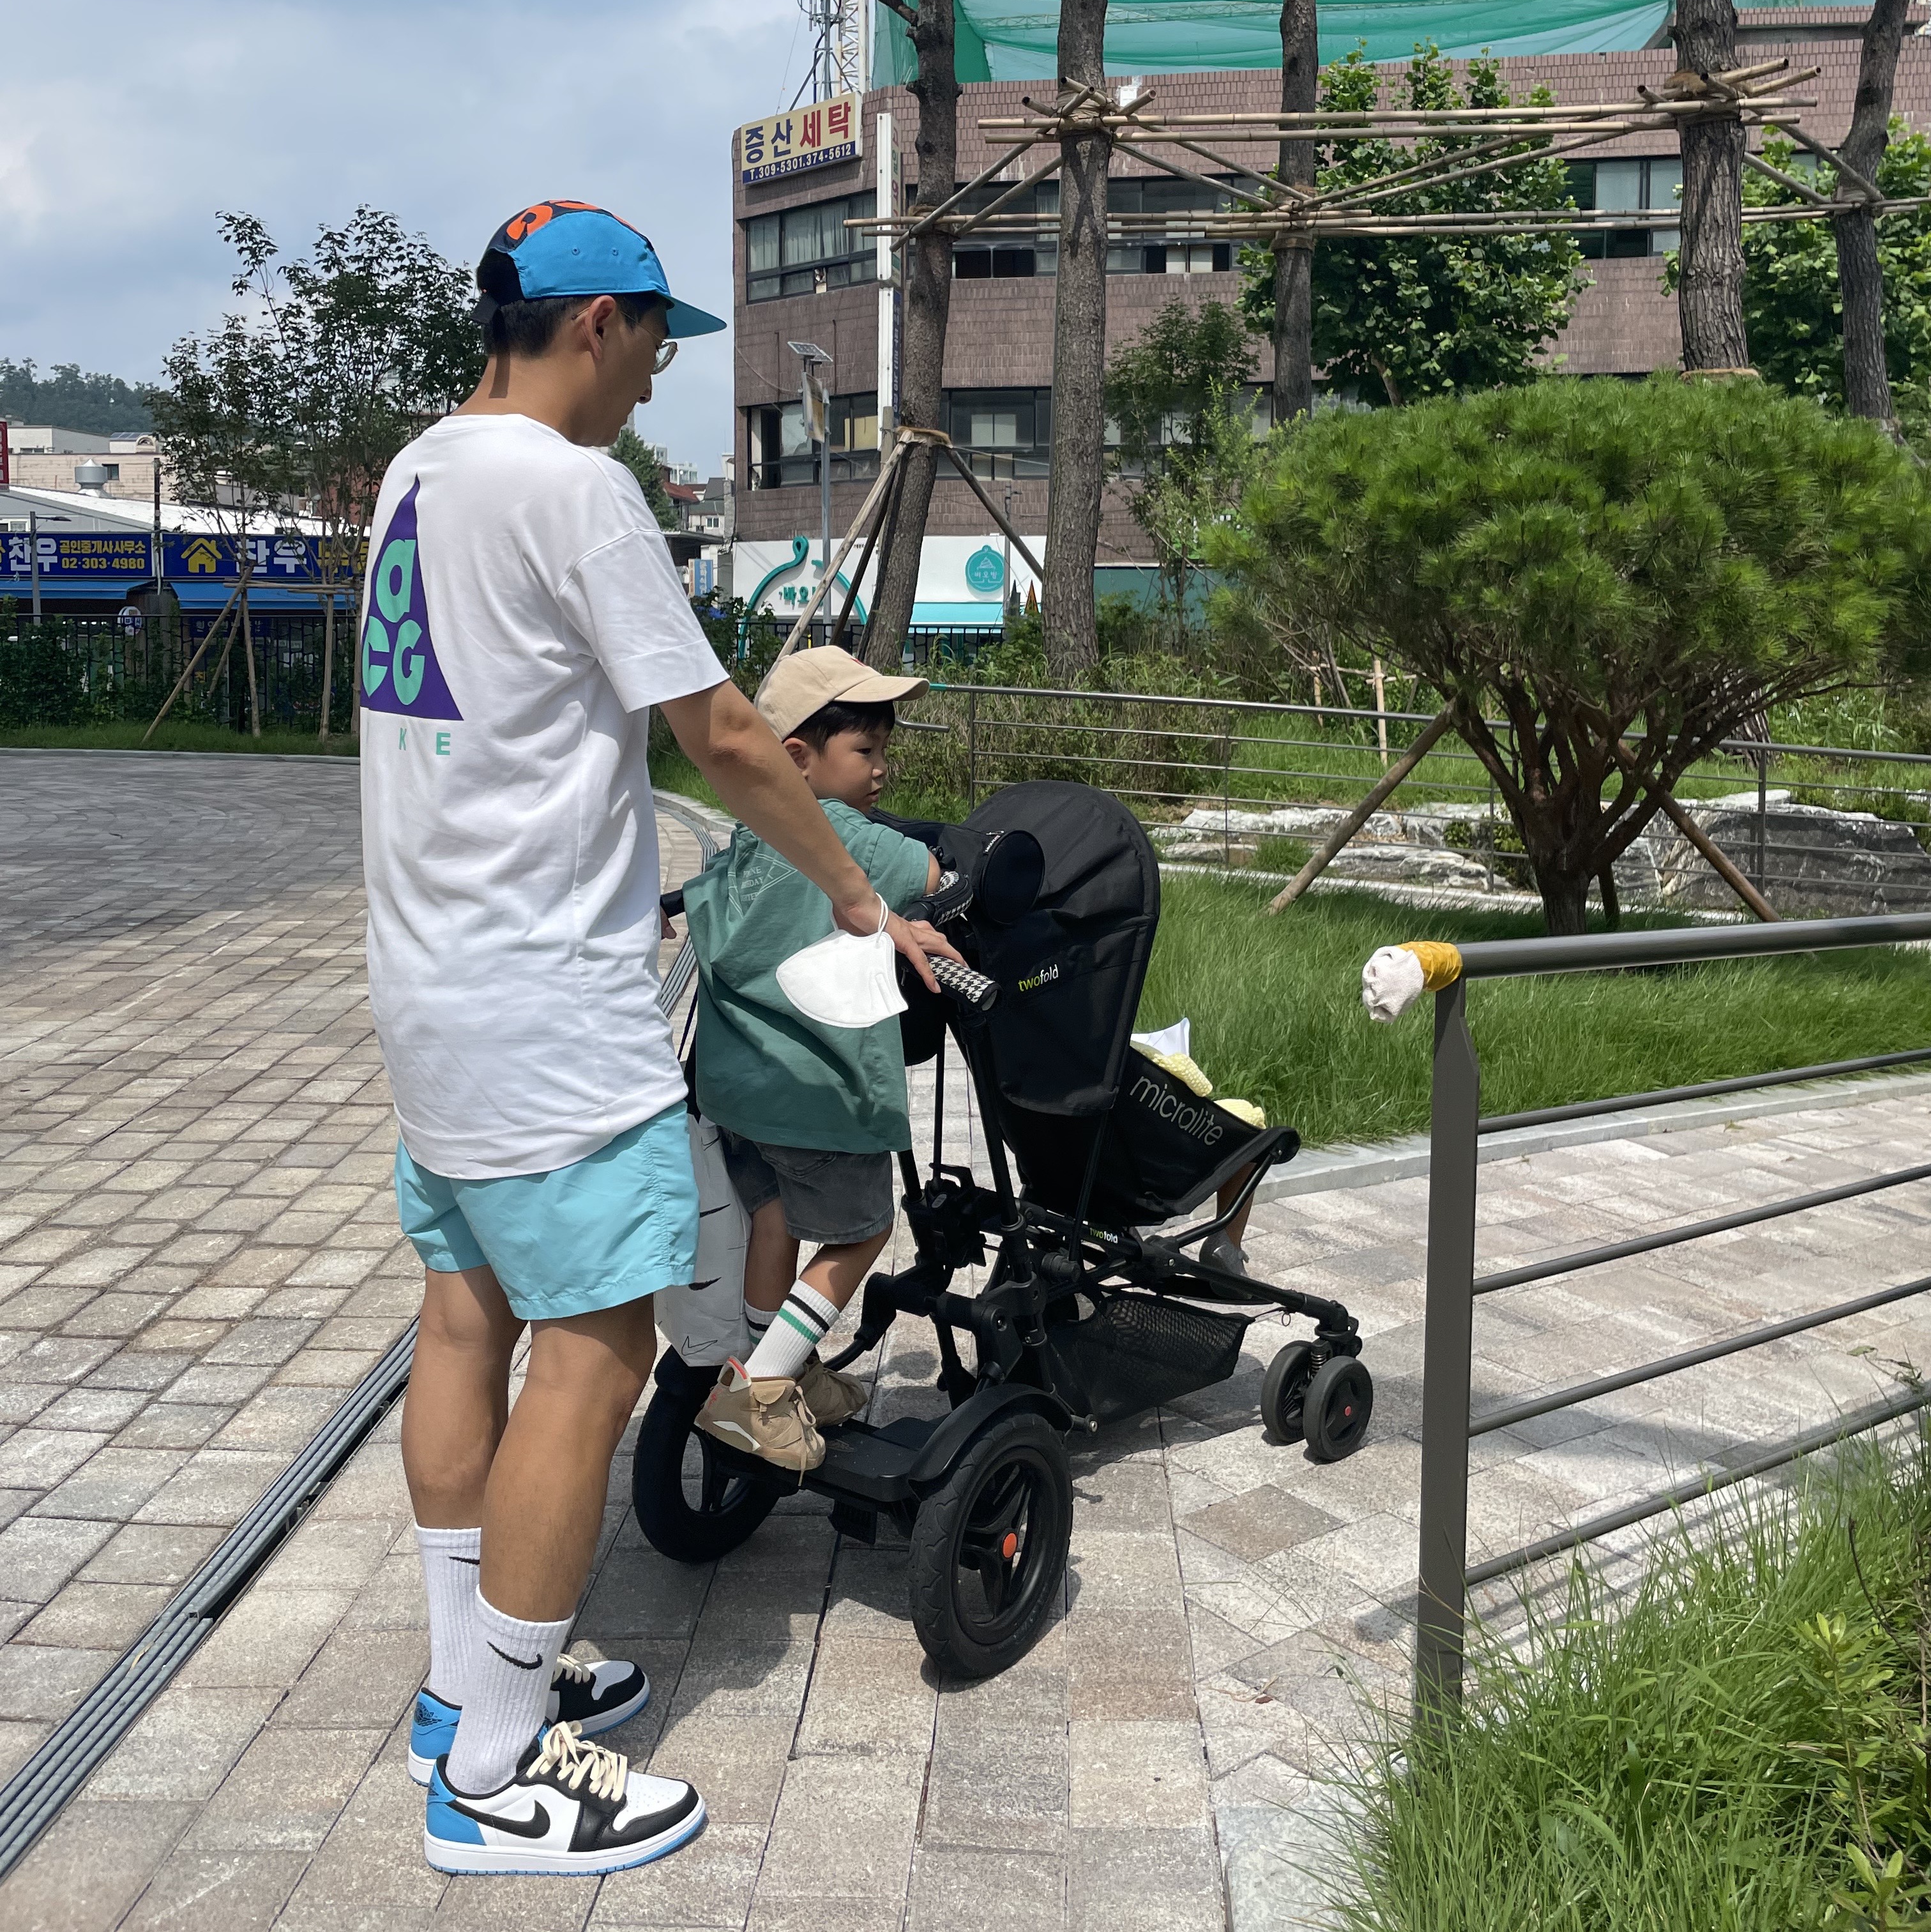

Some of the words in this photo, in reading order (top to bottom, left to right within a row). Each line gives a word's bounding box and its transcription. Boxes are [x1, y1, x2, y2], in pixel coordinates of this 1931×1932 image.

[745, 102, 851, 164] 증산세탁
[60, 540, 146, 554] 공인중개사사무소
[1018, 964, 1059, 992] twofold
[1129, 1076, 1223, 1146] micralite
[1089, 1227, 1118, 1244] twofold
